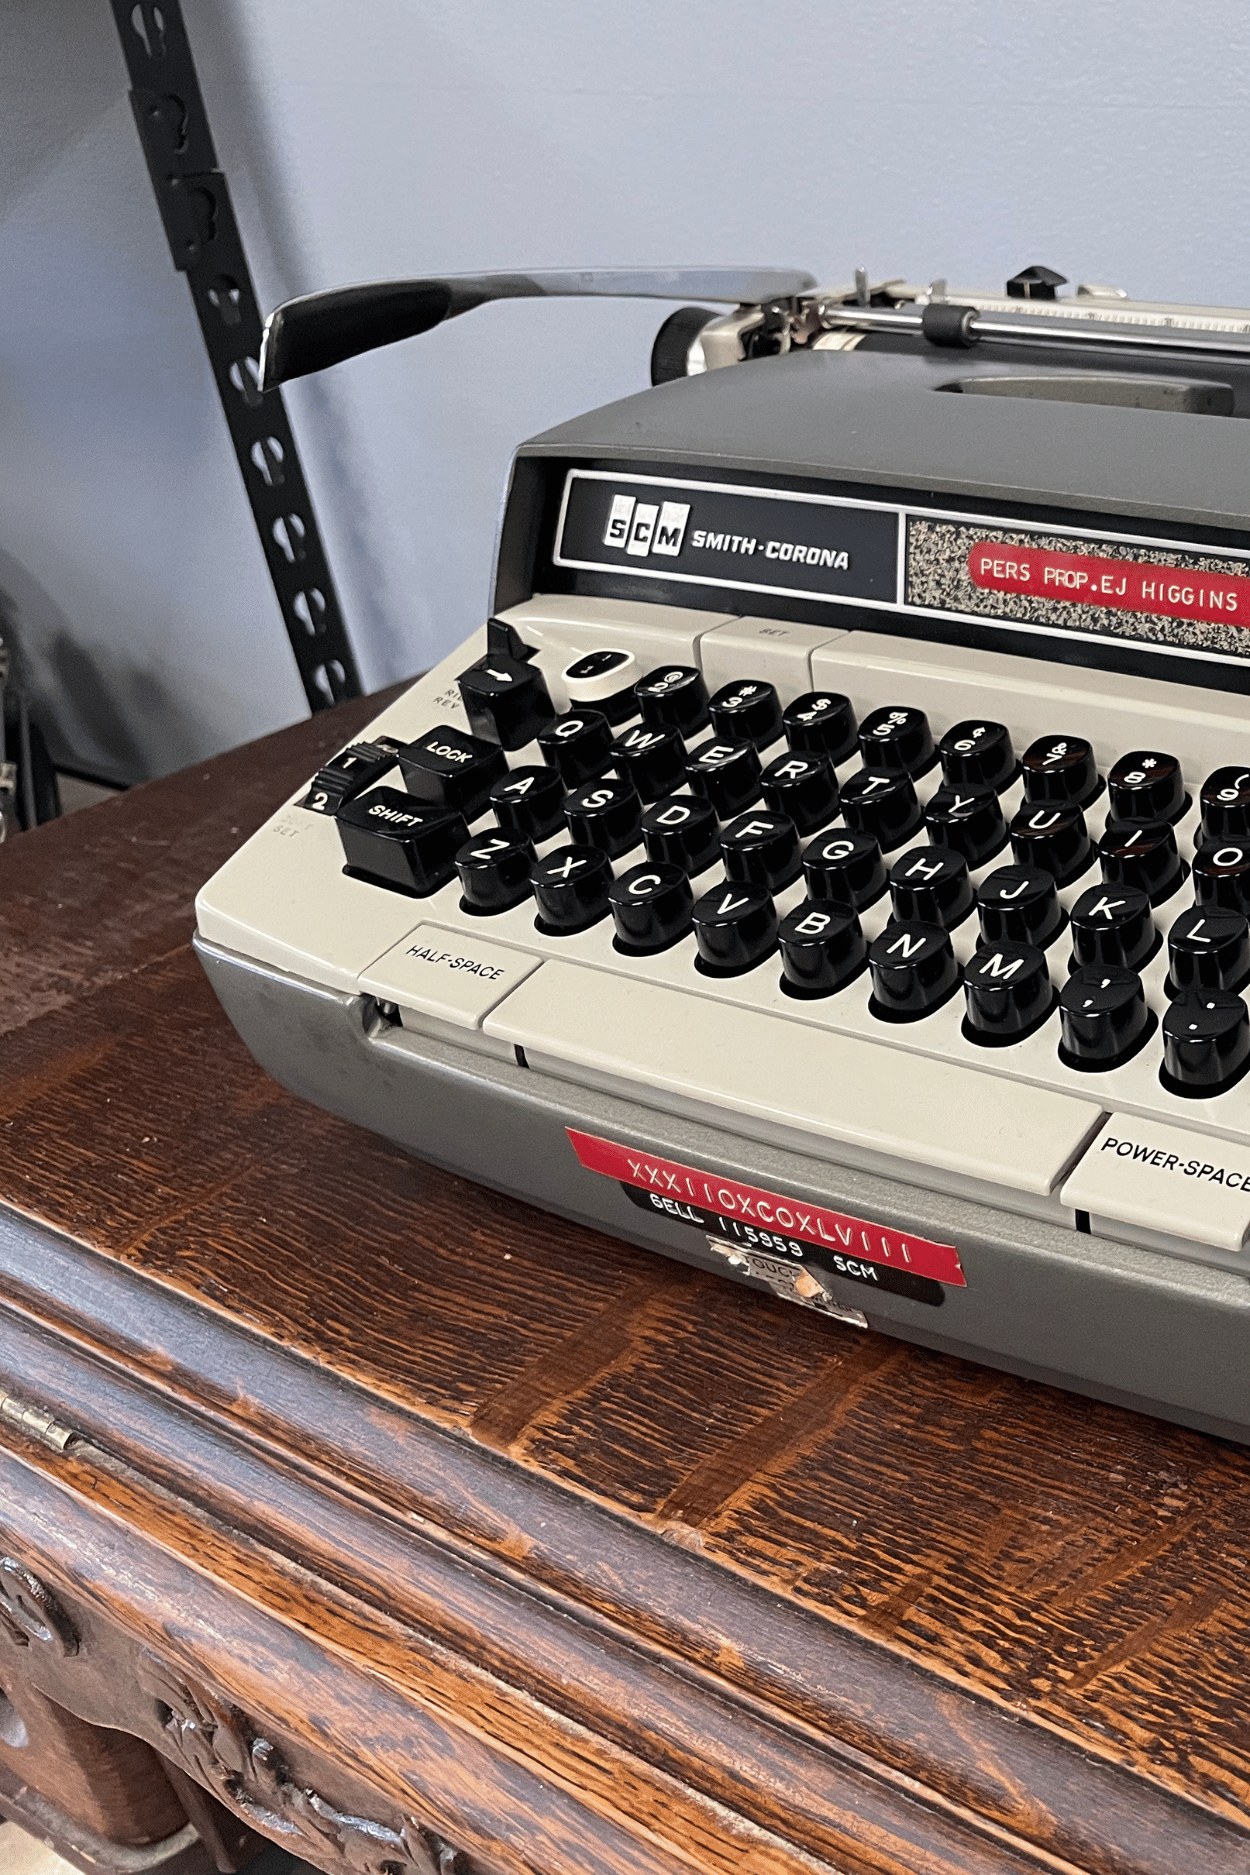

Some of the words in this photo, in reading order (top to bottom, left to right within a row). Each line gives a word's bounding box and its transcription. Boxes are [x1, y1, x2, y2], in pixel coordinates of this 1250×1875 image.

[980, 558, 1031, 582] PERS
[1141, 581, 1239, 612] HIGGINS
[662, 669, 685, 684] @
[738, 685, 757, 697] #
[433, 696, 460, 710] REV
[722, 696, 743, 708] 3
[811, 698, 832, 711] $
[796, 707, 819, 722] 4
[887, 712, 908, 725] %
[554, 720, 584, 738] Q
[622, 727, 666, 749] W
[872, 723, 895, 736] 5
[426, 741, 473, 763] LOCK
[699, 745, 734, 764] E
[954, 739, 976, 751] 6
[1050, 742, 1067, 757] &
[342, 757, 357, 769] 1
[1042, 750, 1065, 766] 7
[774, 760, 809, 779] R
[1123, 771, 1146, 784] 8
[503, 776, 535, 795] A
[861, 776, 892, 795] T
[1216, 788, 1239, 801] 9
[310, 791, 329, 811] 2
[581, 789, 614, 808] S
[948, 795, 975, 813] Y
[368, 804, 424, 827] SHIFT
[656, 805, 691, 825] D
[1028, 810, 1061, 829] U
[735, 820, 774, 838] F
[470, 838, 510, 860] Z
[822, 840, 855, 860] G
[1212, 847, 1243, 867] O
[546, 856, 587, 879] X
[904, 857, 944, 881] H
[628, 874, 661, 895] C
[999, 880, 1030, 900] J
[716, 893, 749, 915] V
[1088, 896, 1126, 920] K
[794, 911, 831, 935] B
[1186, 918, 1211, 943] L
[886, 933, 927, 958] N
[405, 944, 505, 981] HALF-SPACE
[978, 953, 1025, 980] M
[719, 1216, 804, 1258] 115959
[833, 1254, 879, 1282] SCM
